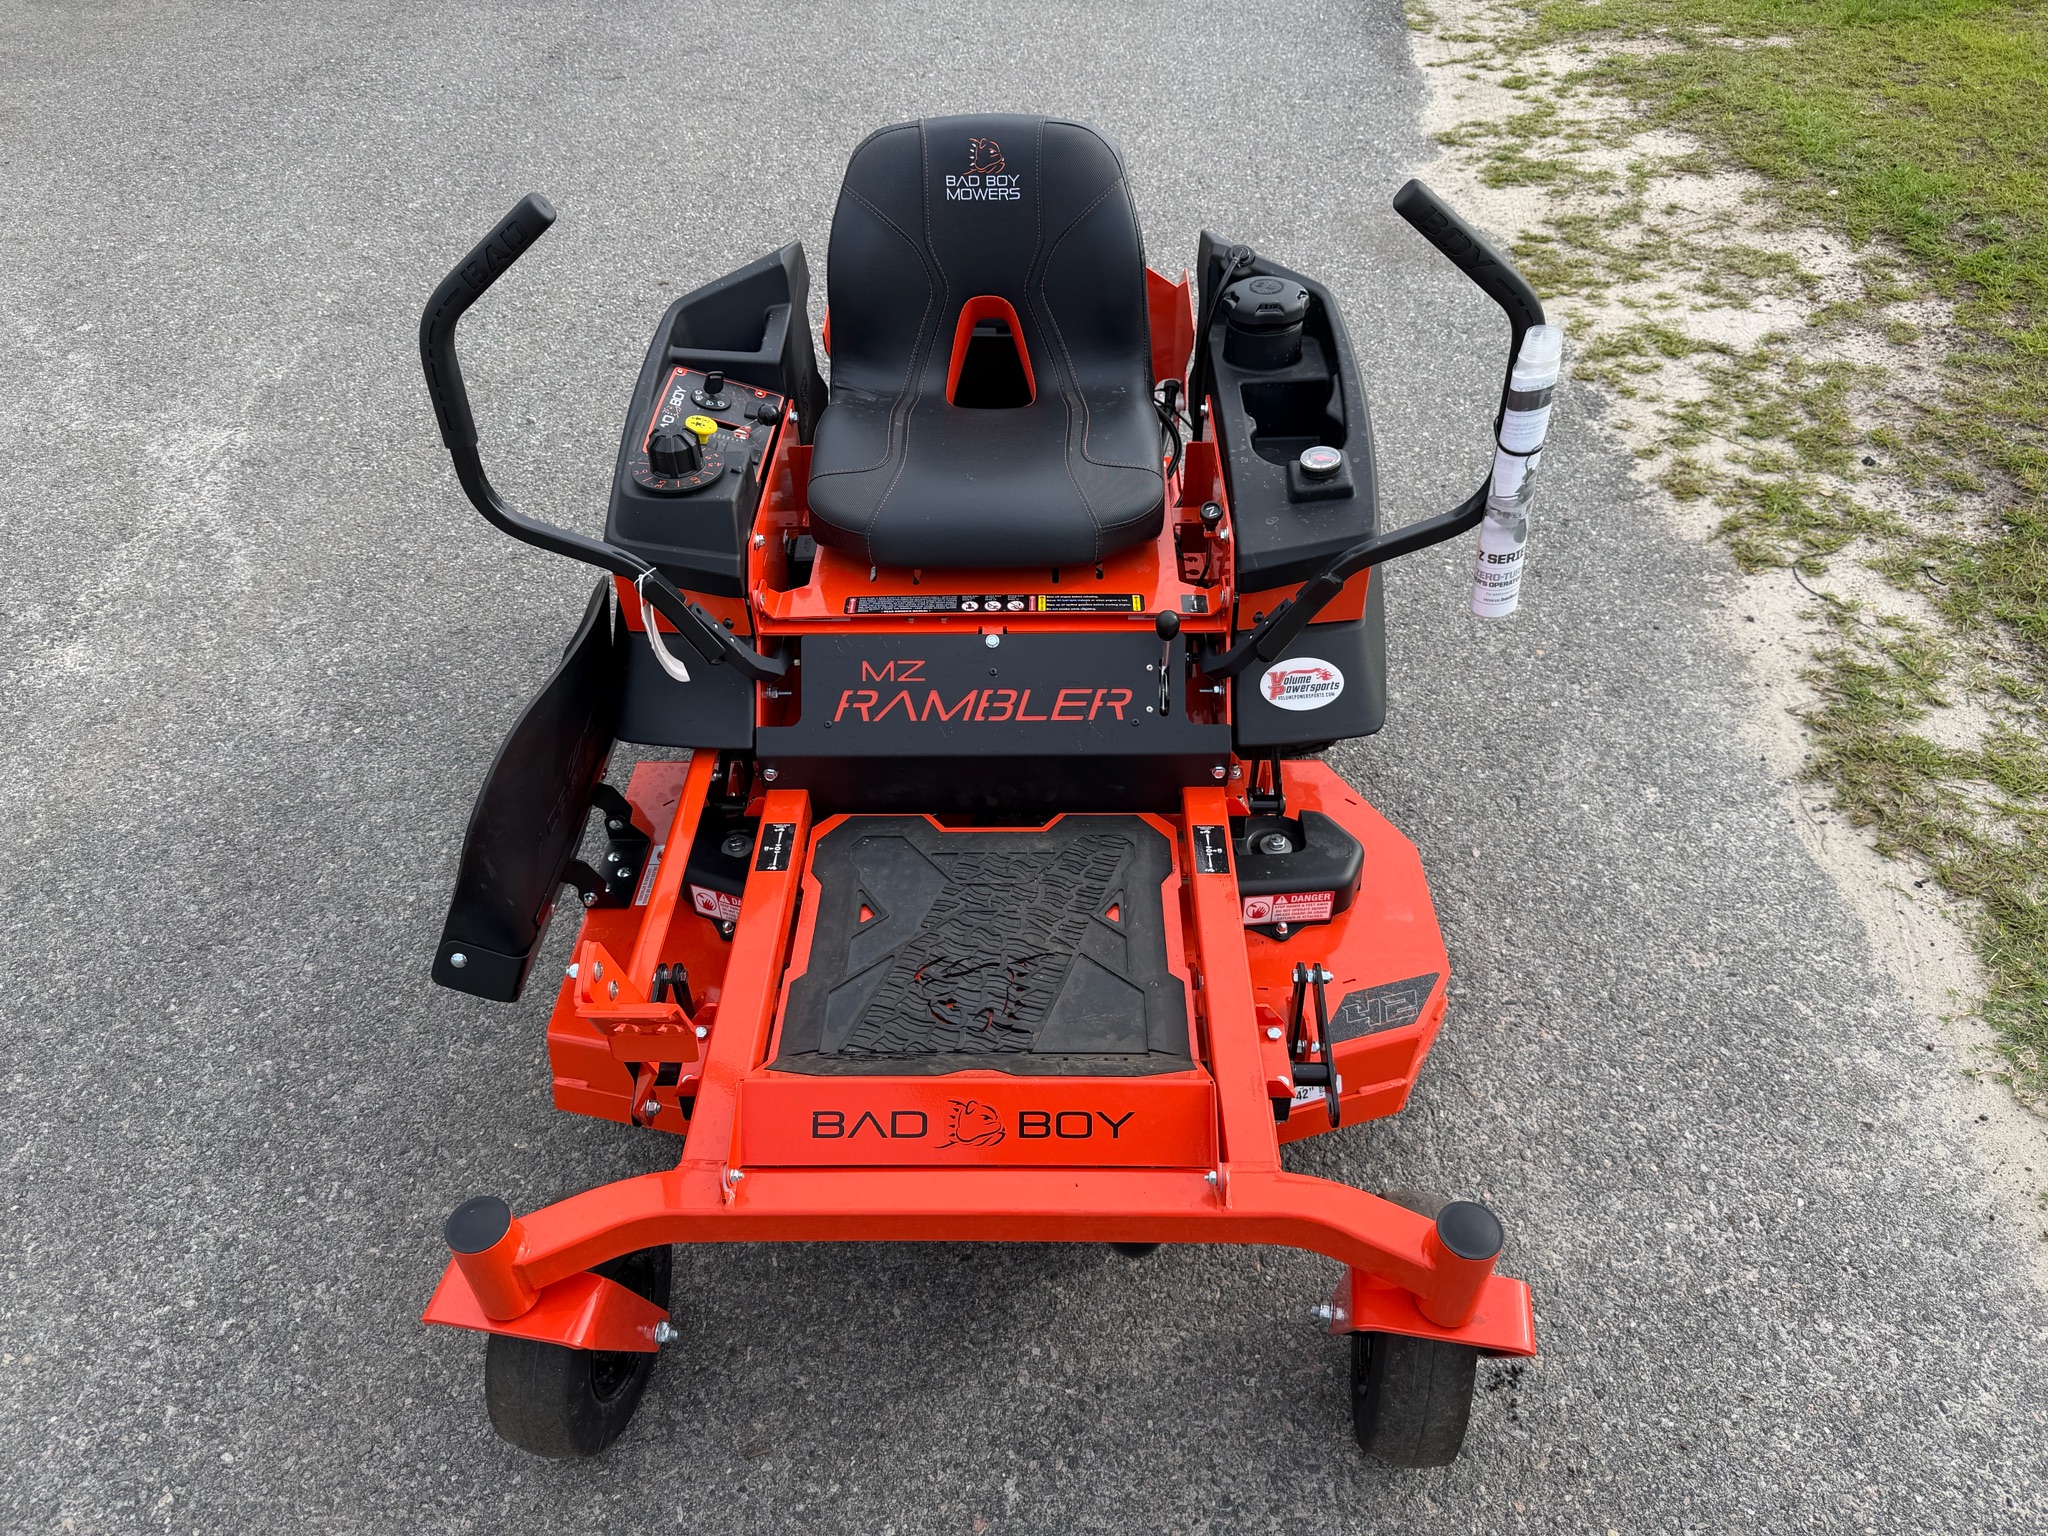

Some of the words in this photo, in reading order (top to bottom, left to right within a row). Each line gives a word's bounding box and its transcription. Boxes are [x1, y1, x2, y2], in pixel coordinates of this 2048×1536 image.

[945, 175, 980, 187] BAD
[986, 174, 1020, 187] BOY
[946, 187, 1021, 201] MOWERS
[1413, 205, 1497, 271] BOY
[460, 220, 528, 290] BAD
[670, 385, 687, 406] BOY
[1487, 546, 1525, 564] SERIE
[862, 660, 926, 682] MZ
[1267, 671, 1312, 686] Volume
[1267, 681, 1340, 700] Powersports
[833, 688, 1133, 722] RAMBLER
[1291, 893, 1331, 902] DANGER
[1342, 989, 1418, 1027] 42
[812, 1110, 928, 1139] BAD
[1018, 1110, 1136, 1139] BOY
